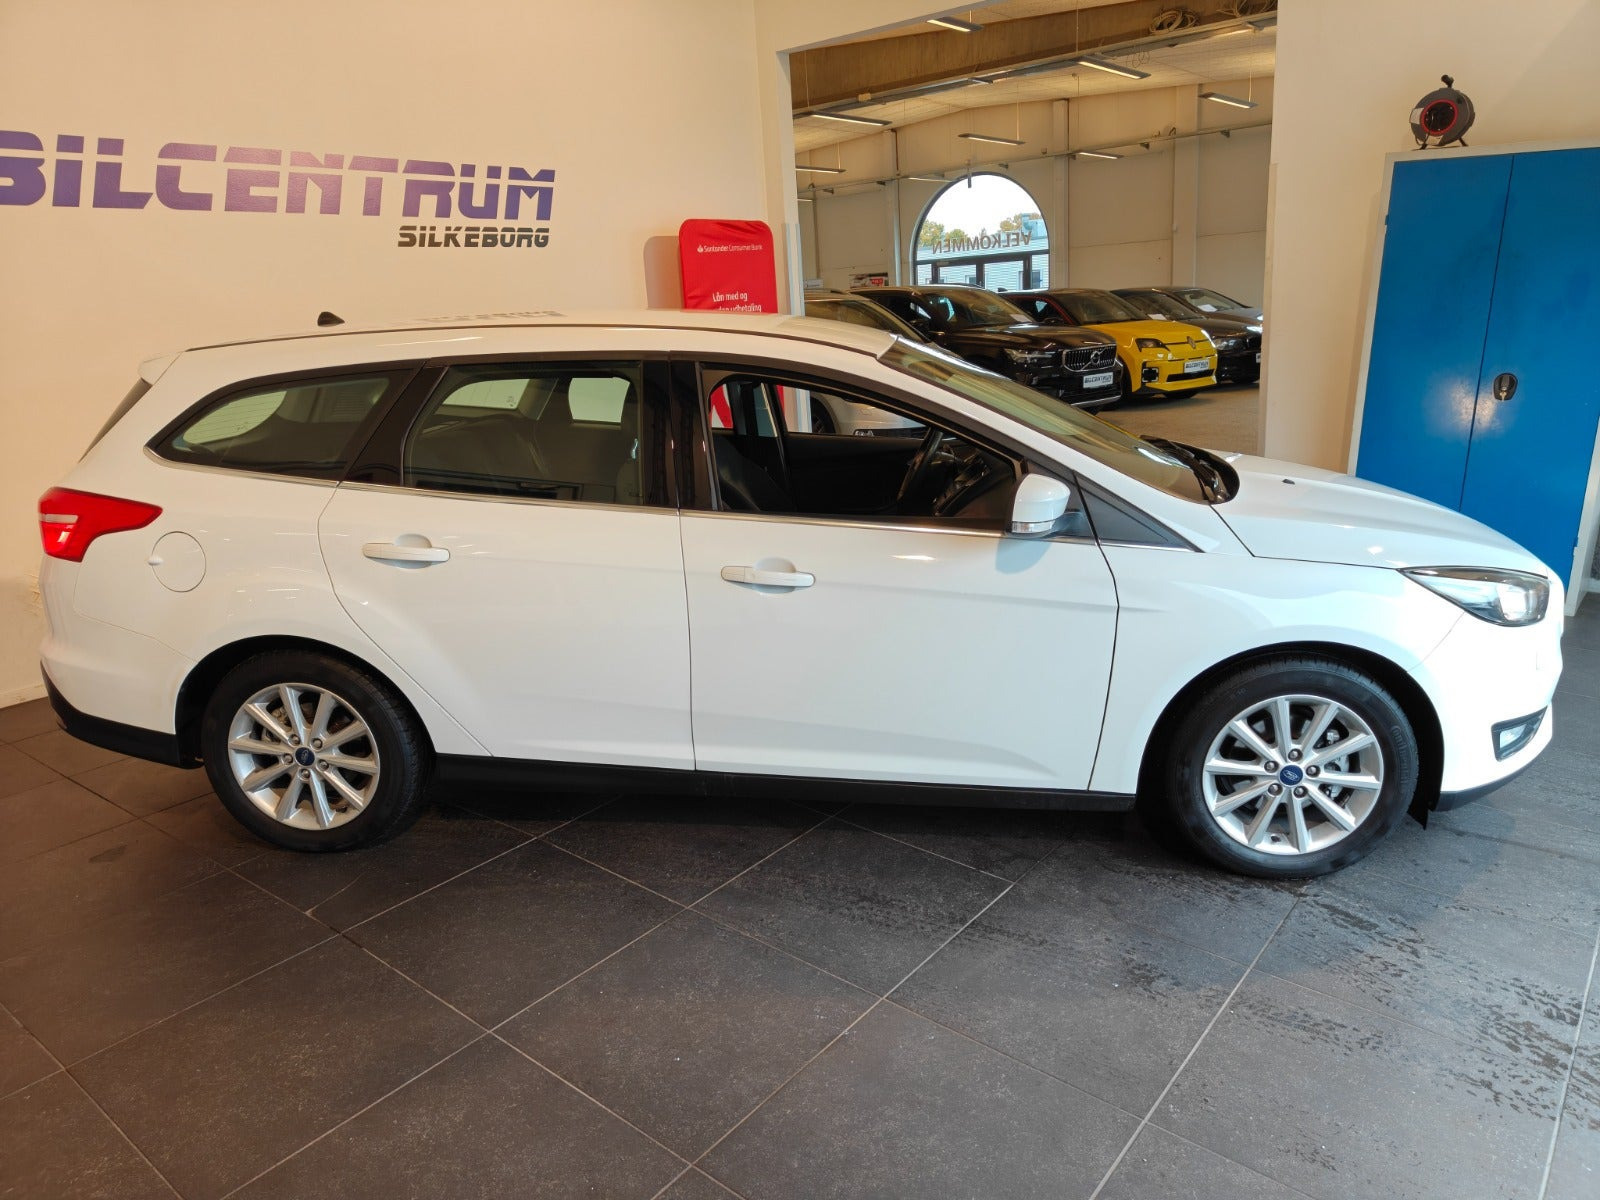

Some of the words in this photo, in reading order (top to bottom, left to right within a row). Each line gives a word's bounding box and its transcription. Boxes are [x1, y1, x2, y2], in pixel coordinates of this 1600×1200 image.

[0, 130, 556, 221] BILCENTRUM
[398, 225, 550, 248] SILKEBORG
[712, 291, 724, 302] Lån
[726, 291, 738, 301] med
[740, 292, 748, 302] og
